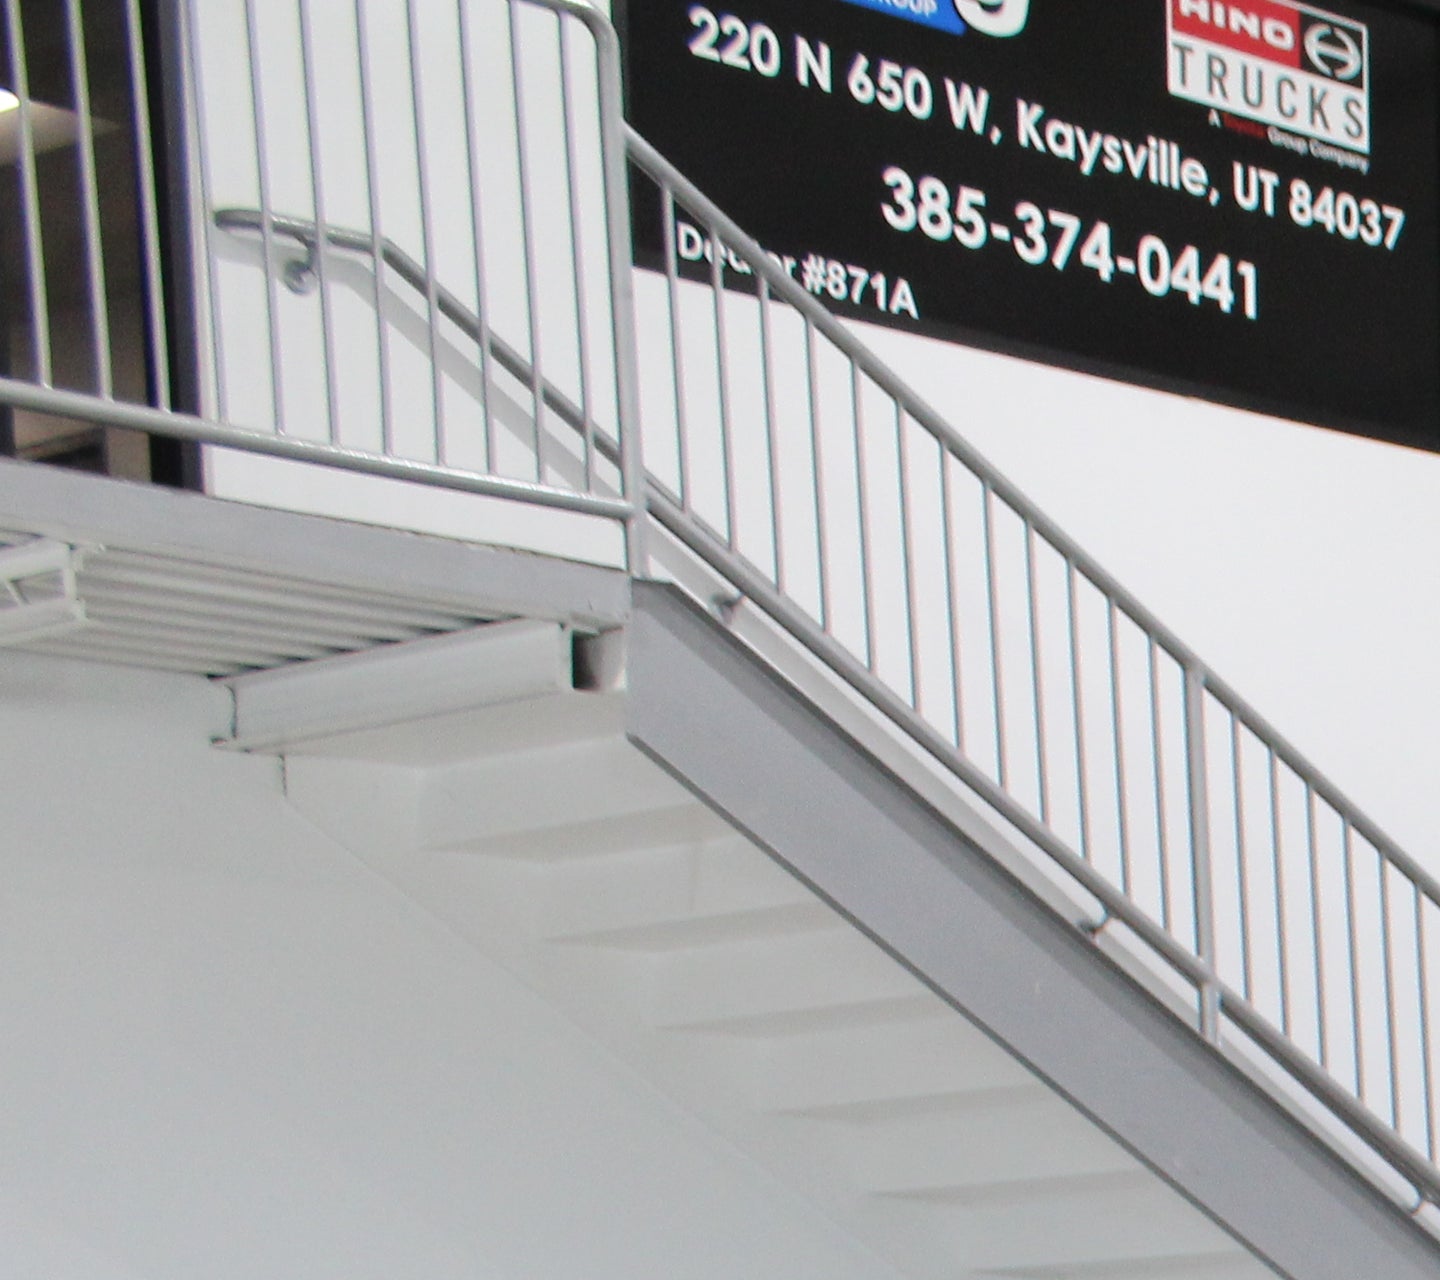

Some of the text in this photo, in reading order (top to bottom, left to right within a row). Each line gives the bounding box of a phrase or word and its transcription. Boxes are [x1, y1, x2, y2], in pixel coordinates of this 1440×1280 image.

[688, 5, 781, 77] 220
[796, 34, 832, 93] N
[848, 53, 932, 120] 650
[944, 77, 1001, 145] W,
[1016, 98, 1219, 206] Kaysville,
[1233, 161, 1280, 217] UT
[1289, 178, 1405, 250] 84037
[1172, 41, 1363, 139] TRUCKS
[801, 253, 919, 320] #871A
[880, 165, 1258, 320] 385-374-0441
